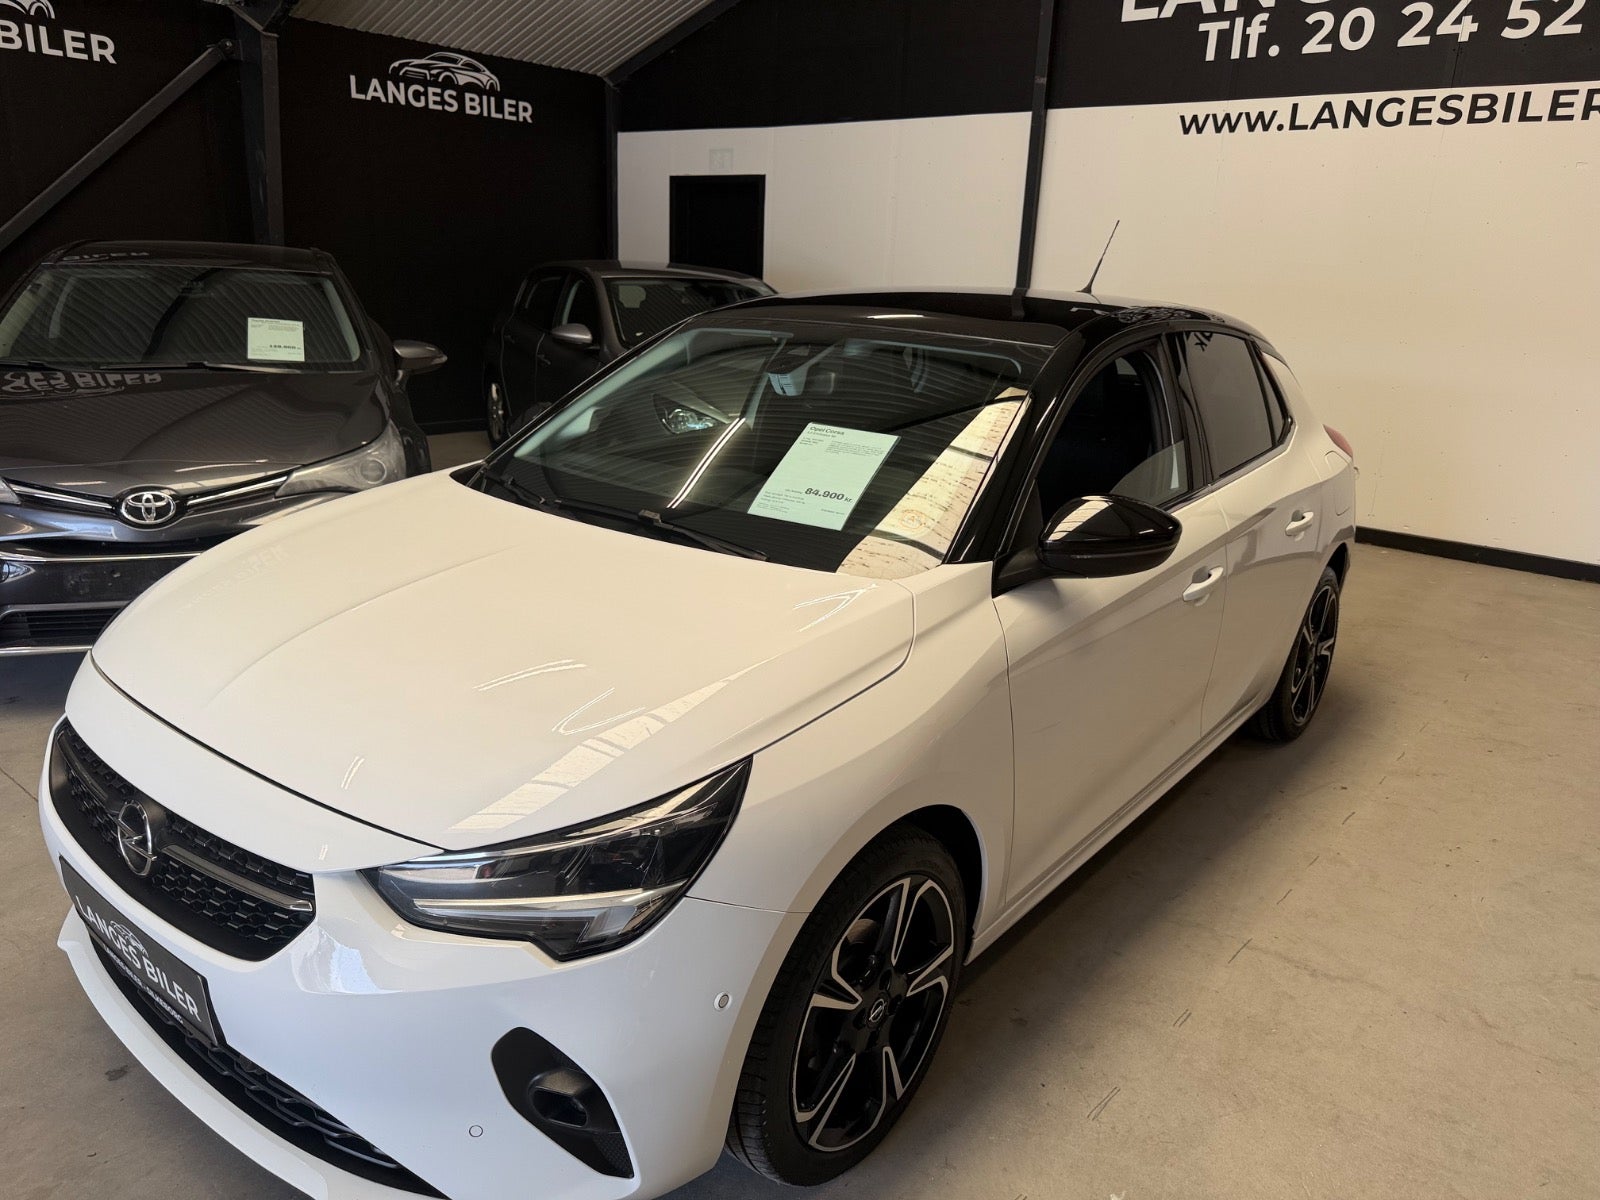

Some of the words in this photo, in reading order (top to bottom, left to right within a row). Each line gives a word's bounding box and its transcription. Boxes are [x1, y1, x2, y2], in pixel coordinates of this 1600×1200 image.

[0, 19, 117, 64] BILER
[1199, 13, 1280, 61] Tlf.
[1302, 7, 1375, 54] 20
[1397, 0, 1479, 47] 24
[1500, 0, 1586, 39] 52
[350, 75, 459, 112] LANGES
[464, 92, 533, 123] BILER
[805, 487, 845, 500] 84.900
[76, 895, 141, 969] LANGES
[142, 956, 202, 1022] BILER
